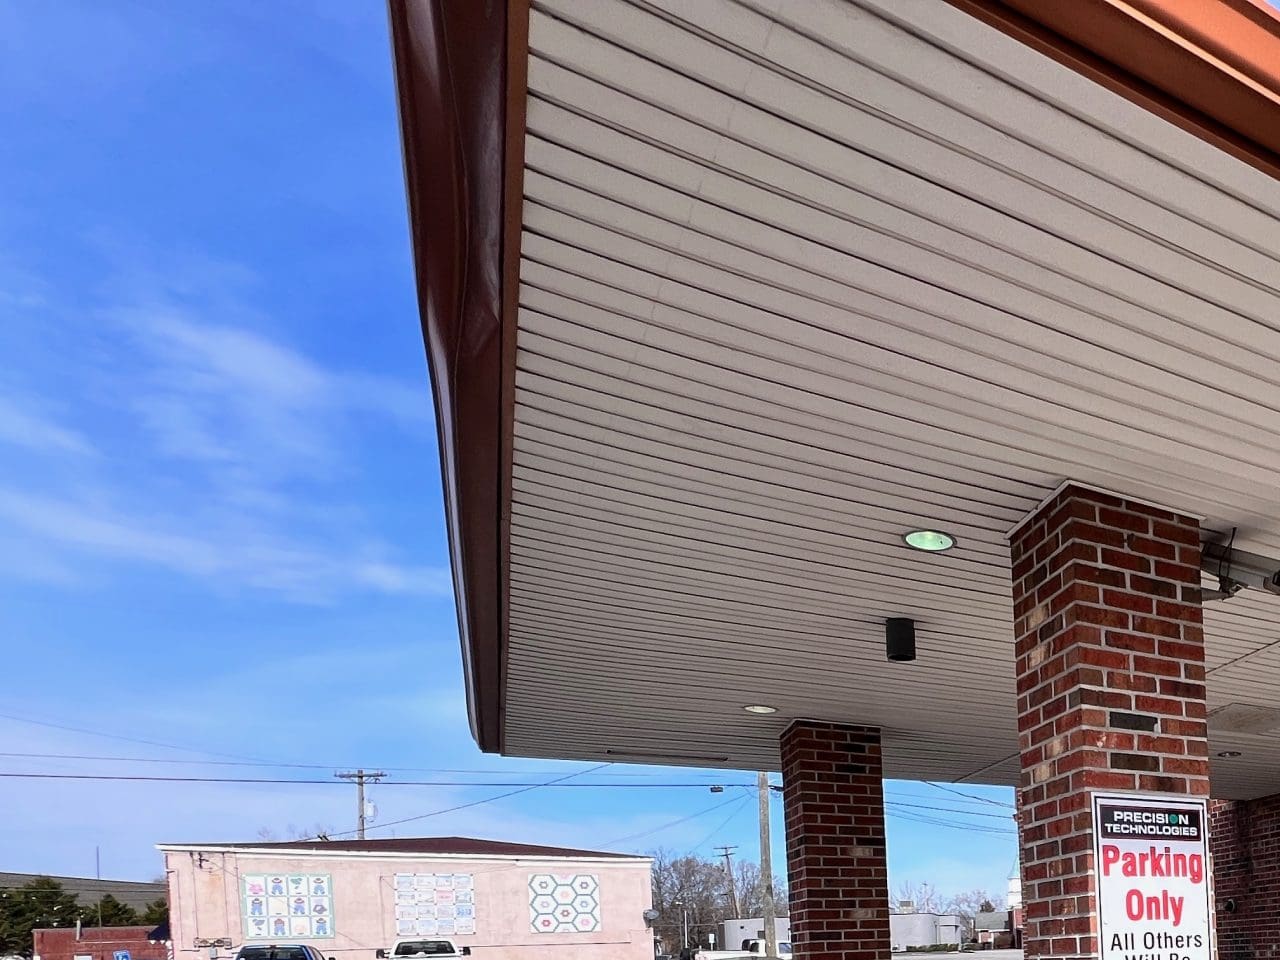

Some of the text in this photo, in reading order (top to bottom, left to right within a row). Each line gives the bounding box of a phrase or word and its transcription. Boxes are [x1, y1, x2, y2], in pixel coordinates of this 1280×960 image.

[1114, 811, 1188, 825] PRECISION
[1105, 823, 1197, 836] TECHNOLOGIES
[1102, 845, 1203, 884] Parking
[1126, 889, 1184, 926] Only
[1111, 932, 1202, 951] All Others
